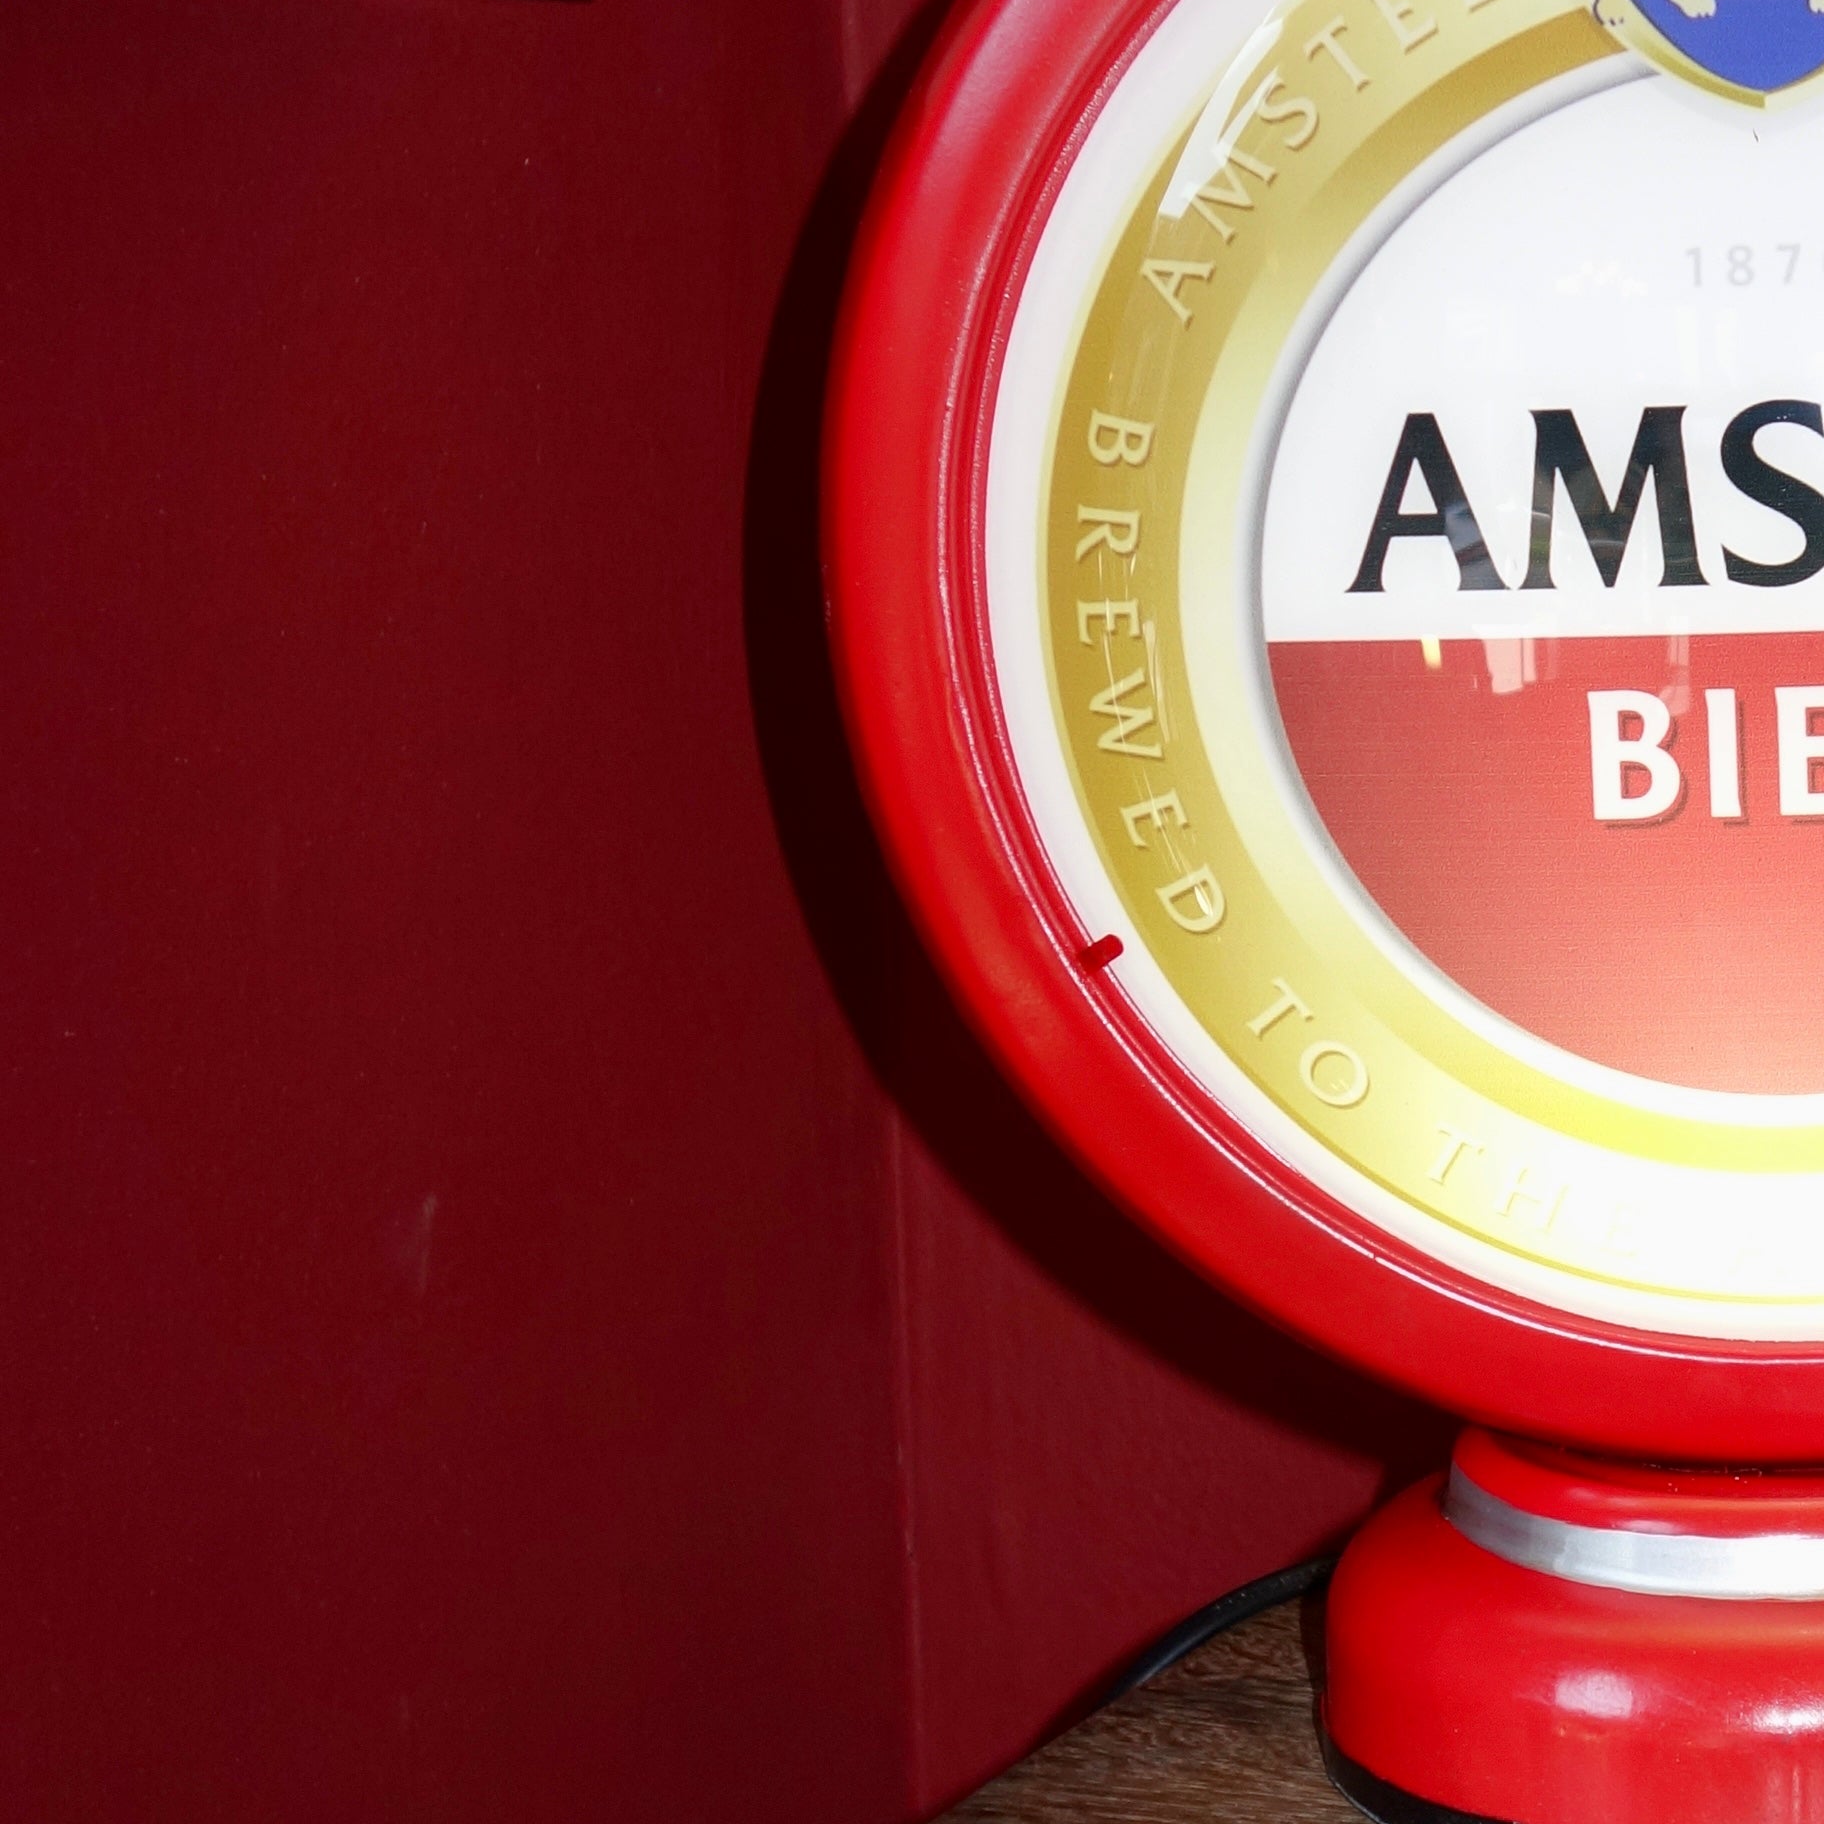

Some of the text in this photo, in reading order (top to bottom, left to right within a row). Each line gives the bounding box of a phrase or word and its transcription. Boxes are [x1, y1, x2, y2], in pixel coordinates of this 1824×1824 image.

[1075, 404, 1230, 938] BREWED
[1244, 976, 1374, 1110] TO
[1422, 1126, 1648, 1262] THE
